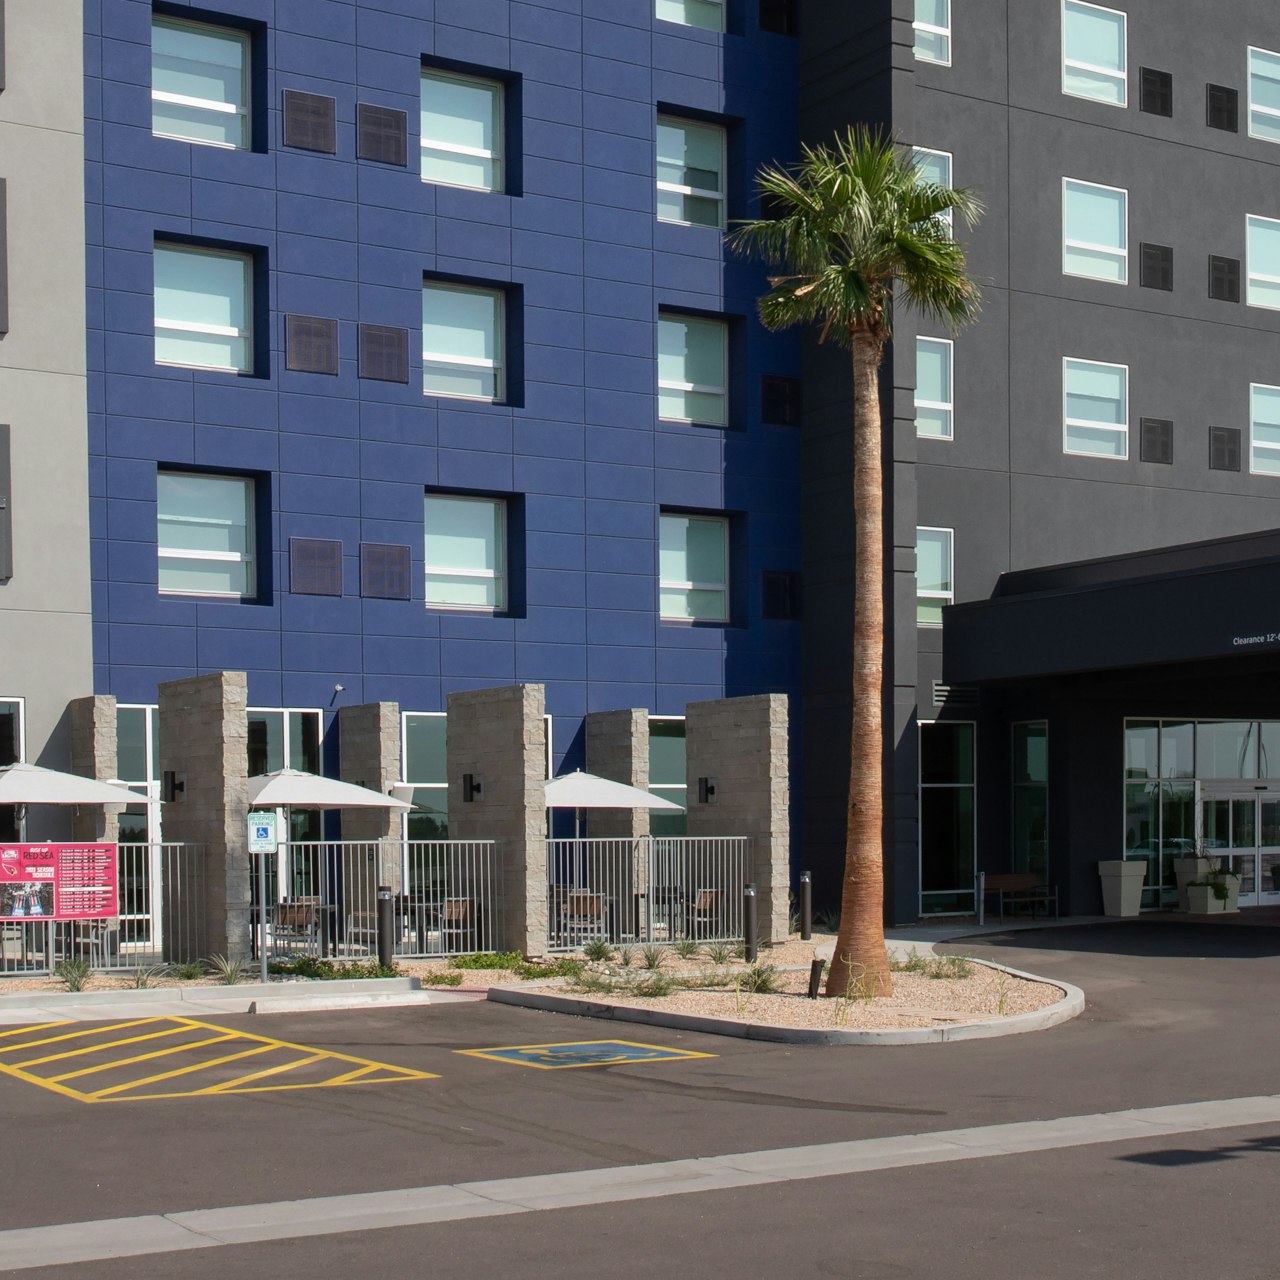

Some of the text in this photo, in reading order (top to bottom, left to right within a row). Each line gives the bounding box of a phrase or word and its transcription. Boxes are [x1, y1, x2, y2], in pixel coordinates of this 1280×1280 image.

[1232, 636, 1265, 645] Clearance
[23, 851, 54, 860] RED SEA
